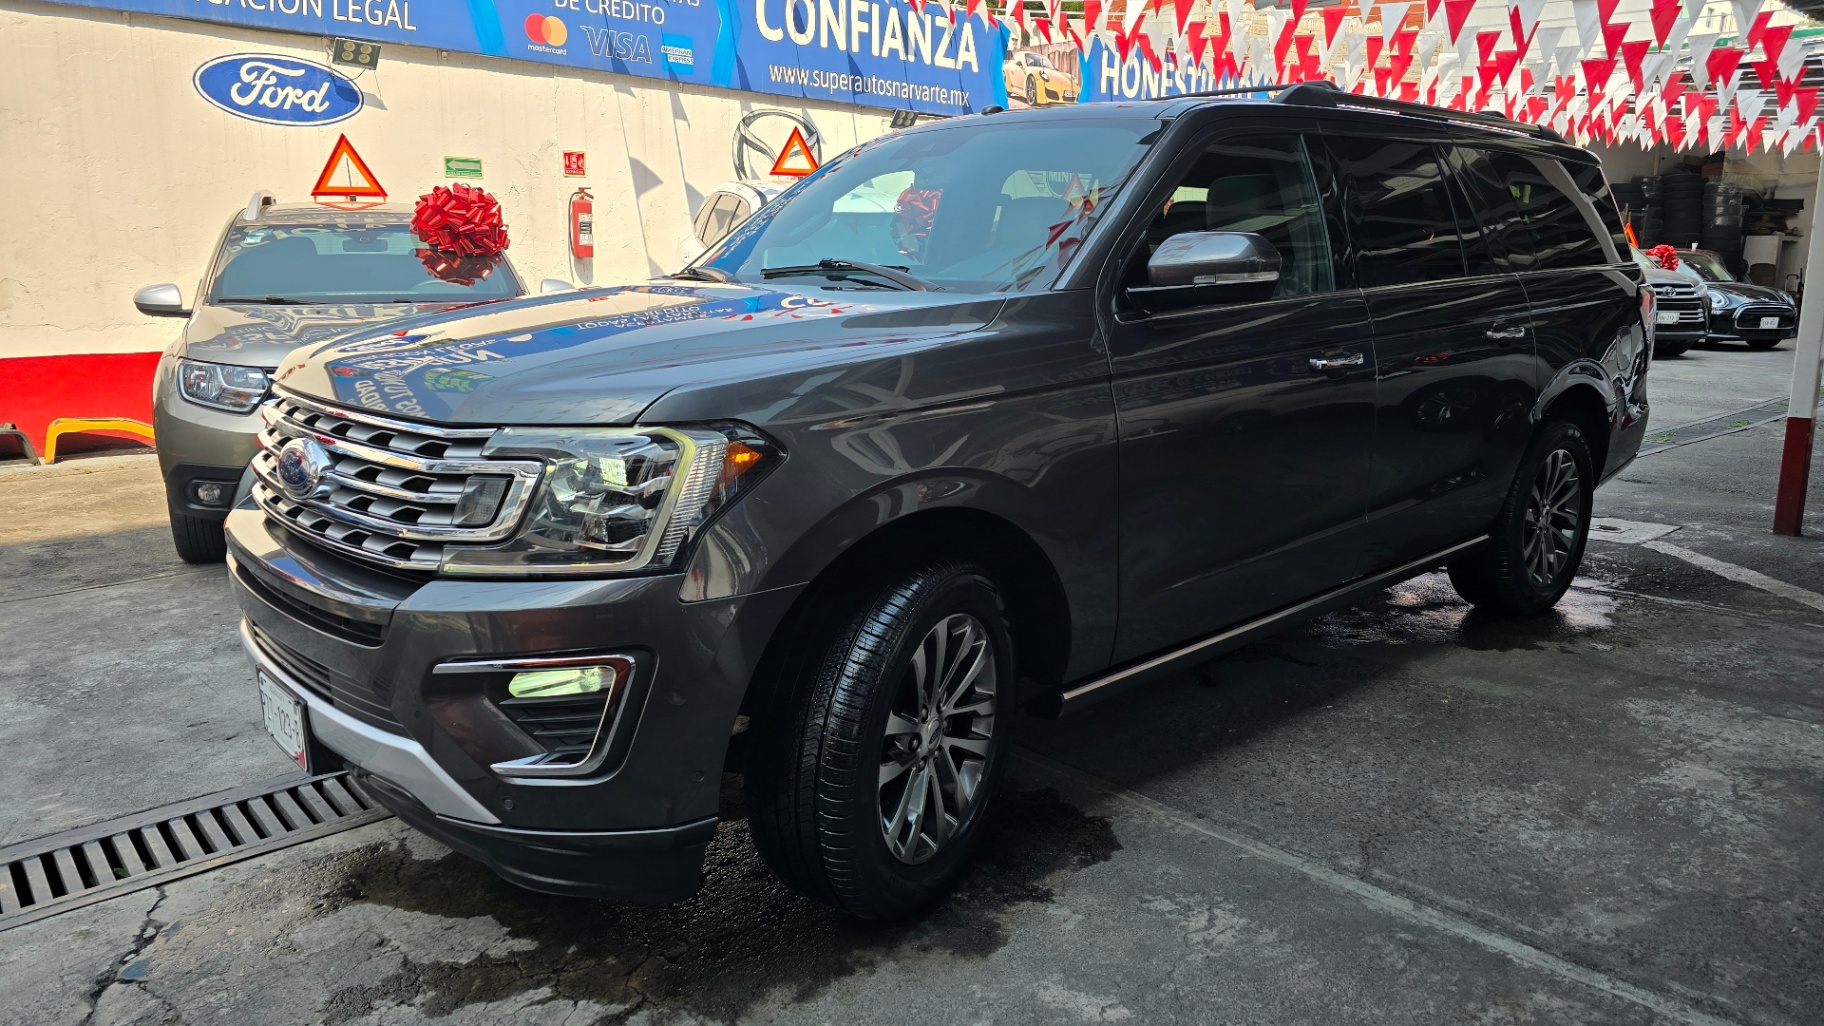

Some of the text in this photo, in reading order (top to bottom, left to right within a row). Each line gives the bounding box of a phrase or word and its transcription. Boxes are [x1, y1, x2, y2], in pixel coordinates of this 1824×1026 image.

[333, 0, 418, 31] LEGAL
[585, 0, 665, 25] CREDITO
[527, 44, 567, 56] mastercard
[580, 25, 652, 64] VISA
[755, 0, 979, 73] CONFIANZA
[231, 61, 331, 113] Ford
[769, 64, 969, 107] www.superautosnarvarte.mx
[1048, 171, 1074, 183] MINI
